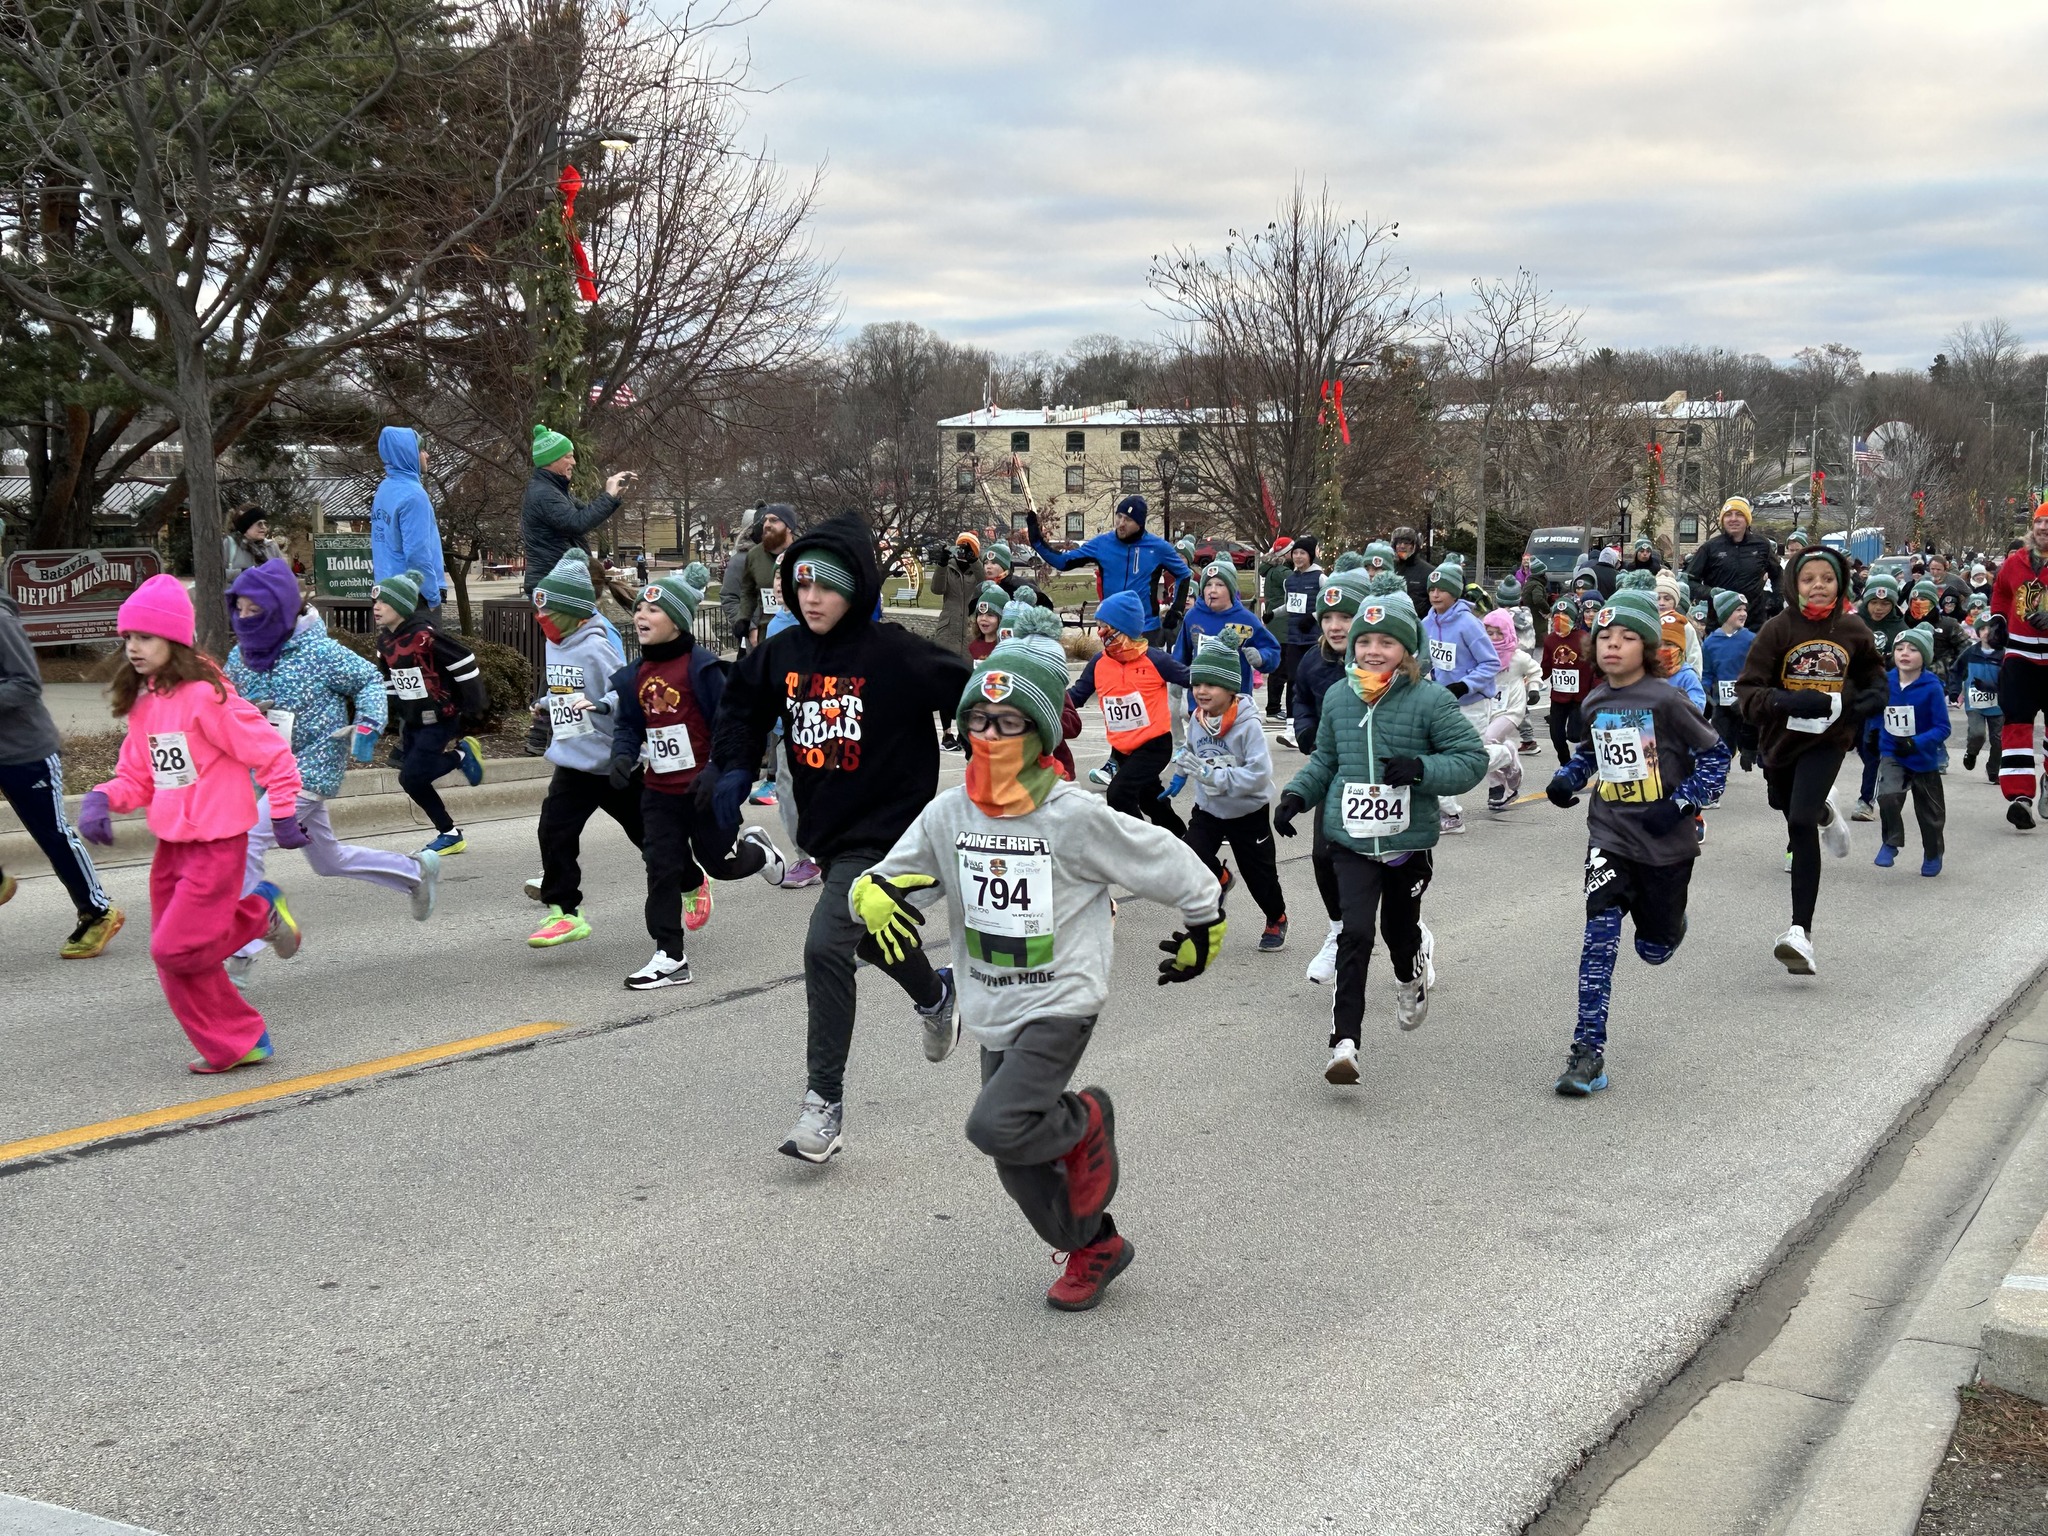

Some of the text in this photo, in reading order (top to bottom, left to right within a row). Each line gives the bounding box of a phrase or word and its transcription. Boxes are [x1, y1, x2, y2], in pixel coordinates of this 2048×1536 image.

[1550, 536, 1579, 544] MOBILE
[39, 554, 90, 581] Batavia
[326, 556, 374, 574] Holiday
[17, 562, 132, 606] DEPOT MUSEUM
[1431, 646, 1453, 662] 2276
[785, 672, 866, 698] TURKEY
[1108, 703, 1142, 721] 1970
[791, 716, 862, 749] SQUAD
[792, 740, 862, 772] 2025
[1347, 797, 1404, 821] 2284
[955, 831, 1051, 856] MINECRAFT
[972, 874, 1032, 911] 794
[1018, 970, 1056, 985] MODE
